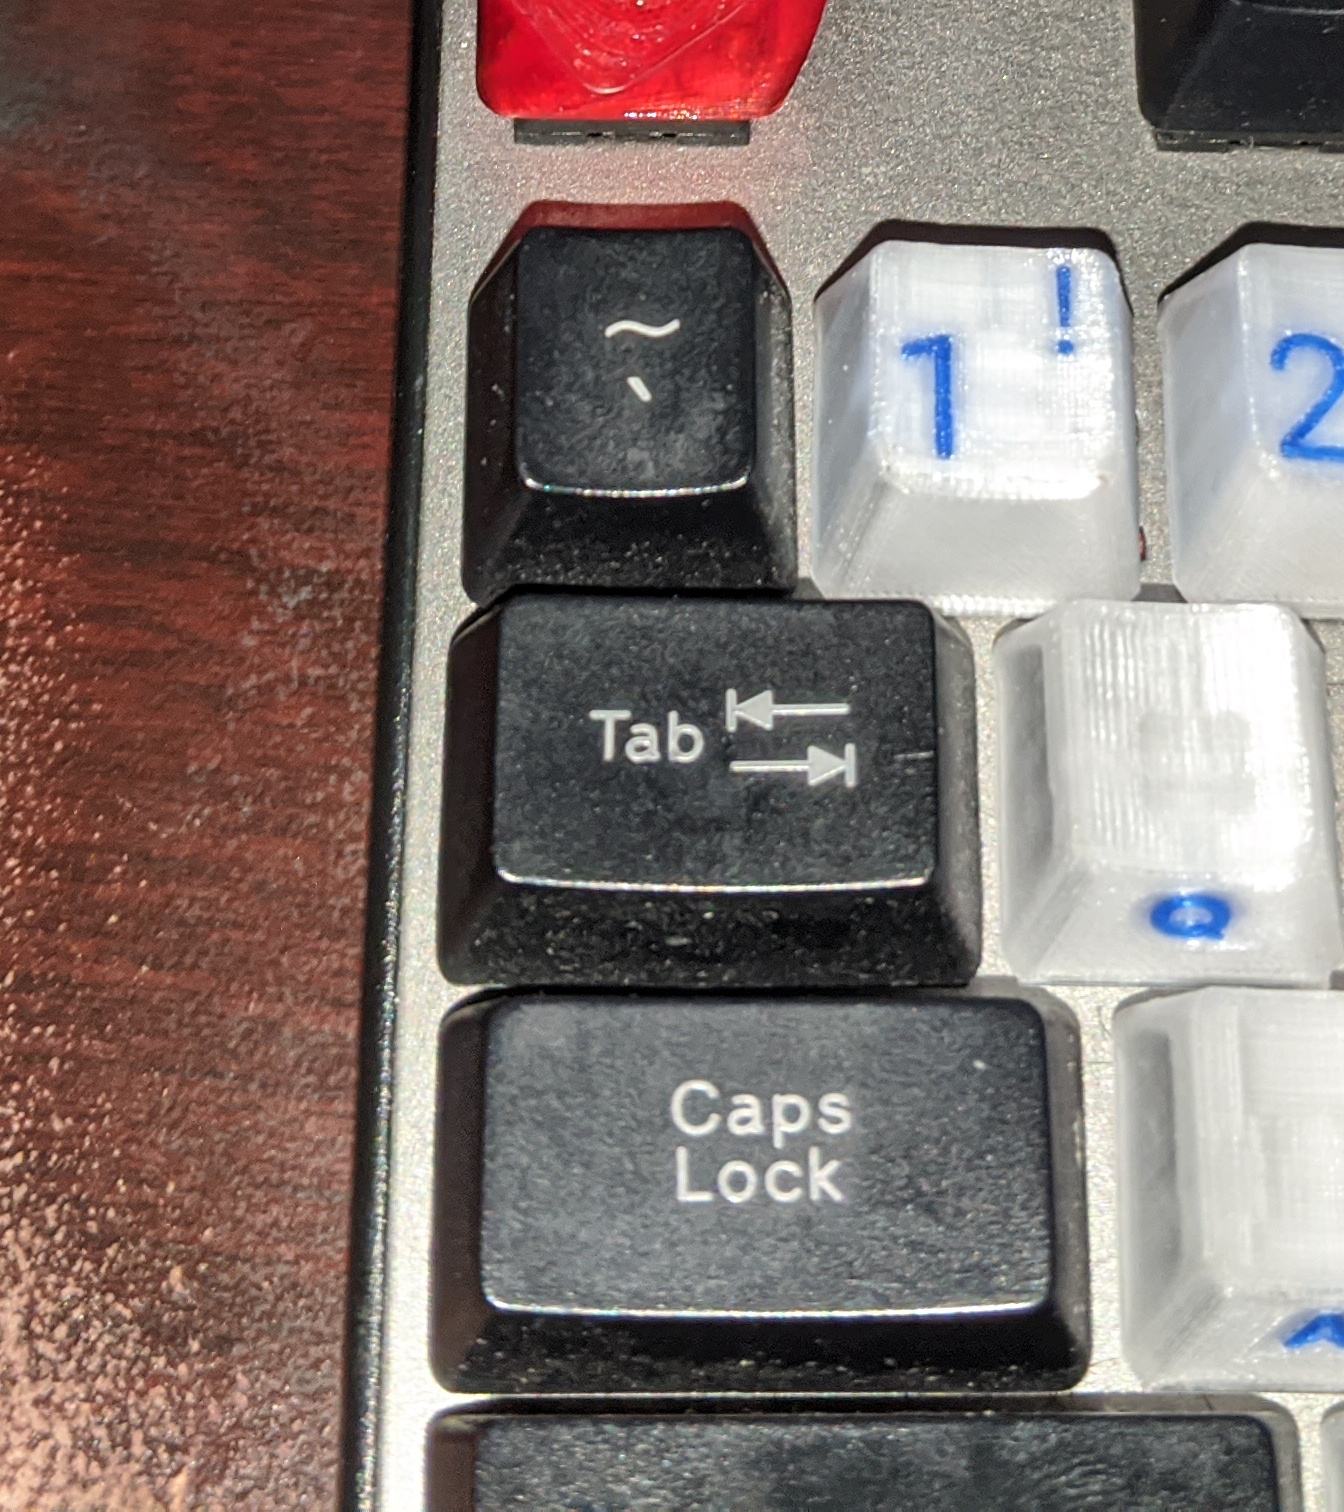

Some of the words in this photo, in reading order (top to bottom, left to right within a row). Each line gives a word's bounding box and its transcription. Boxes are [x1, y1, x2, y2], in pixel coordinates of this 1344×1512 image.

[1054, 264, 1078, 356] !
[901, 334, 957, 460] 1
[588, 708, 706, 765] Tab
[1150, 892, 1233, 941] Q
[670, 1079, 854, 1150] Caps
[675, 1147, 846, 1205] Lock
